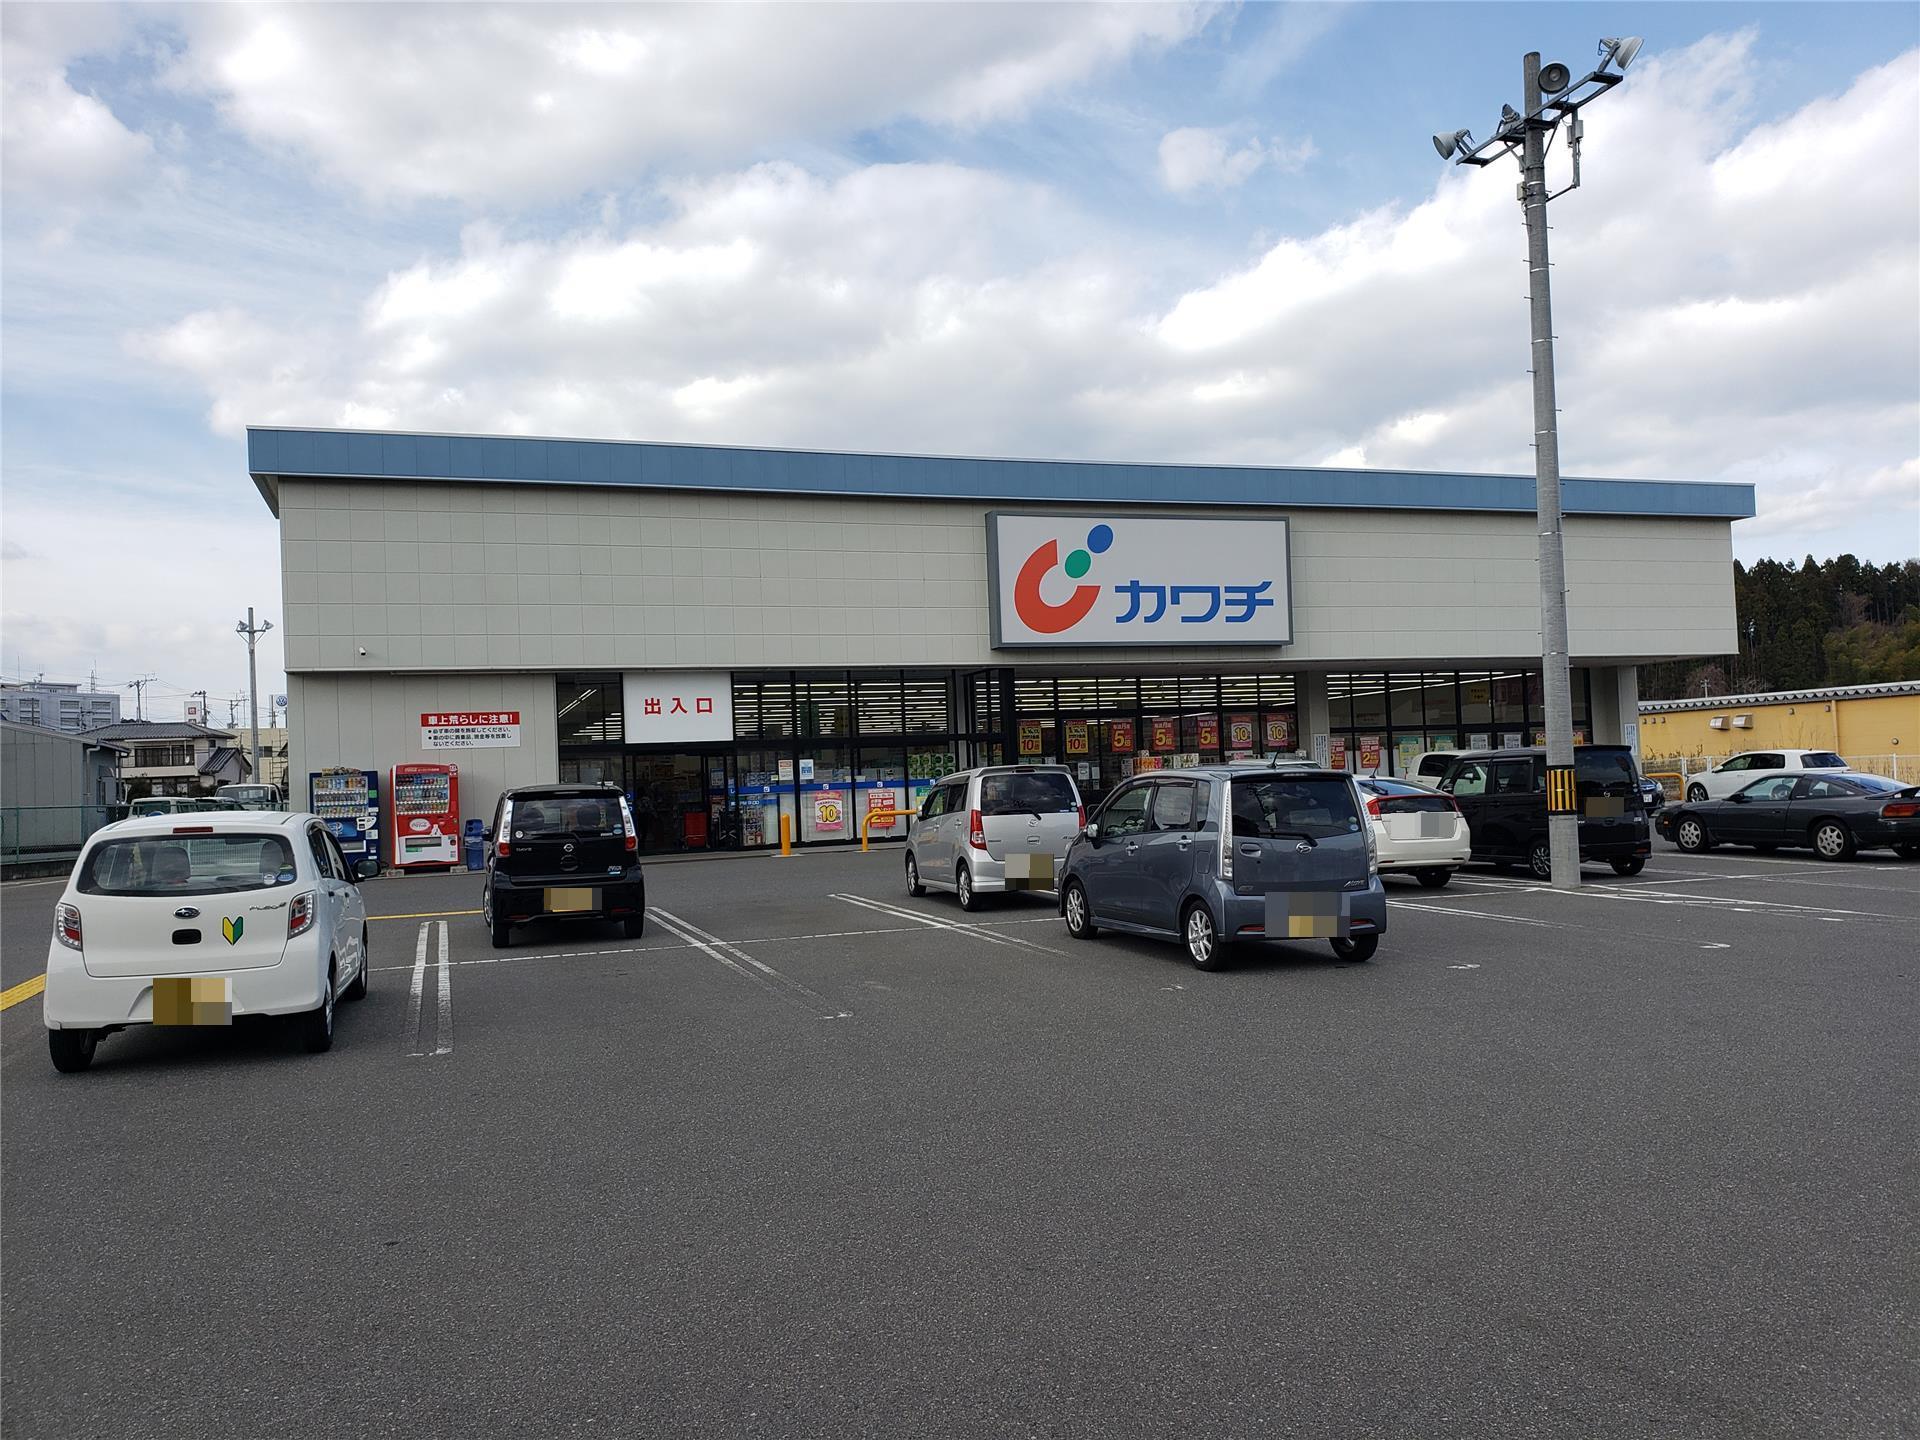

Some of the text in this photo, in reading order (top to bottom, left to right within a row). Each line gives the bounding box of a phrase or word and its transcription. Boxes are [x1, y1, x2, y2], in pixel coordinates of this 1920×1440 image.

[1114, 580, 1274, 624] カワチ
[644, 697, 713, 715] 出入口
[819, 804, 838, 822] 10
